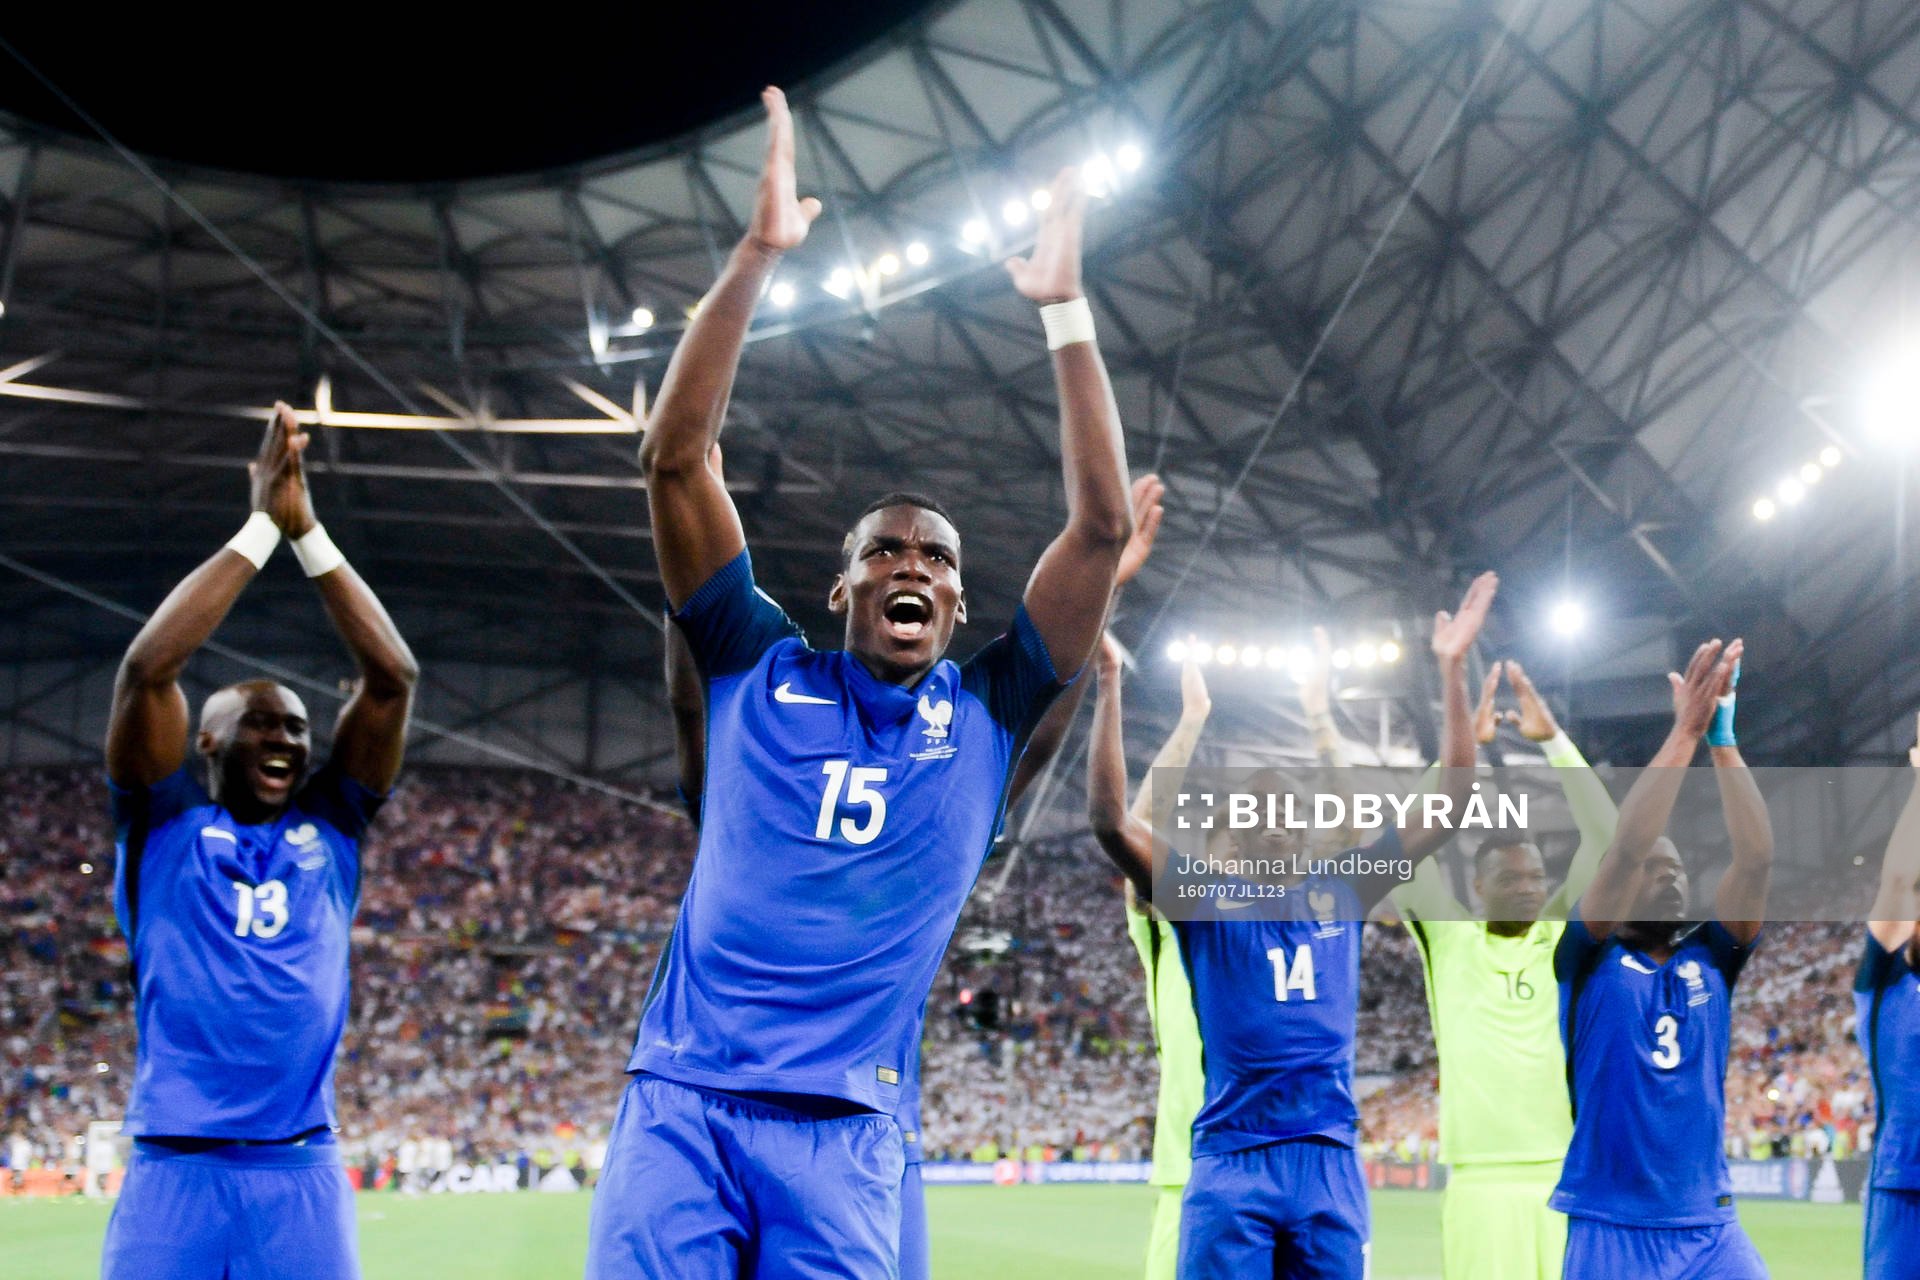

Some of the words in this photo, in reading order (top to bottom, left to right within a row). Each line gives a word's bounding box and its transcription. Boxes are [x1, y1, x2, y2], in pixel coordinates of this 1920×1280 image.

[815, 760, 888, 845] 15
[232, 879, 289, 938] 13
[1267, 944, 1316, 1002] 14
[1497, 969, 1535, 1000] 16
[1652, 1015, 1681, 1069] 3
